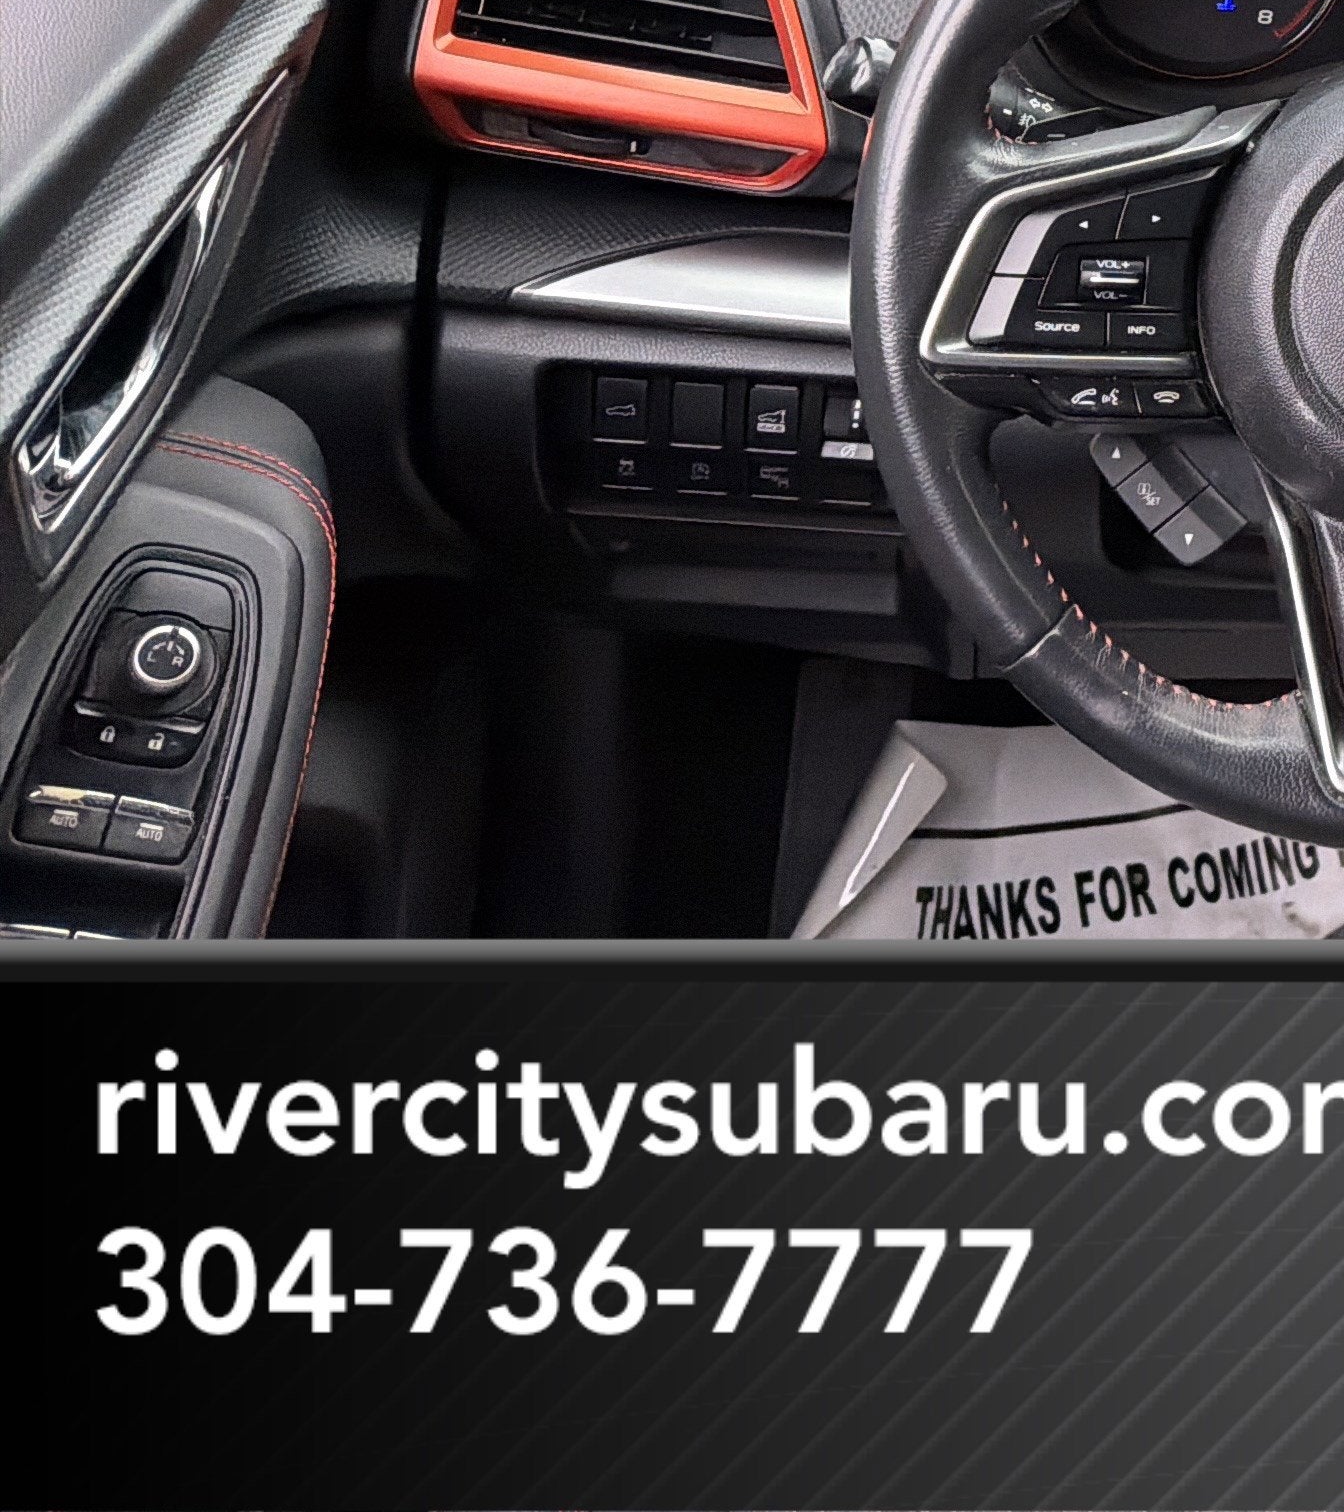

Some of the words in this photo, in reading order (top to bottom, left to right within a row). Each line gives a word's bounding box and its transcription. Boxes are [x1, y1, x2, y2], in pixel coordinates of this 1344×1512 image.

[1257, 9, 1274, 25] 8
[1034, 320, 1081, 333] Source
[1127, 325, 1156, 336] INFO
[49, 814, 78, 829] AUTO
[136, 827, 163, 842] AUTO
[915, 876, 1061, 939] THANKS
[1074, 862, 1158, 928] FOR
[1167, 835, 1320, 908] COMING
